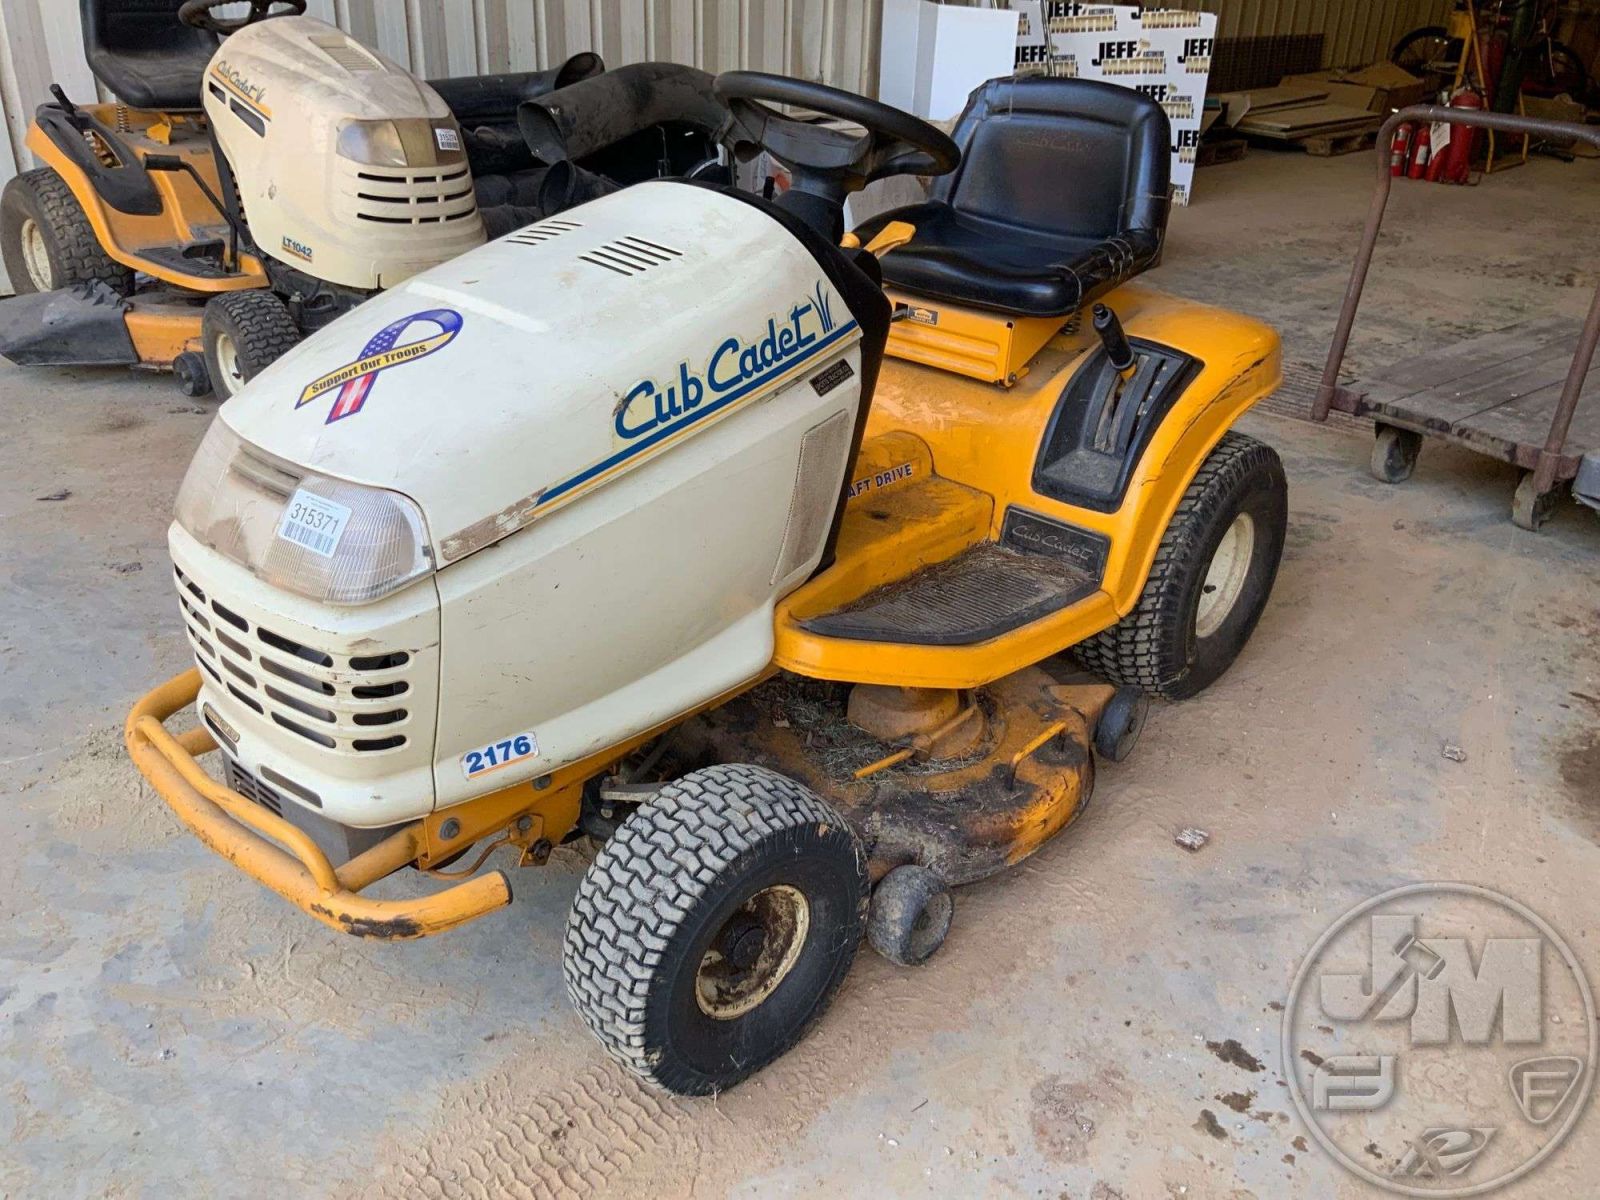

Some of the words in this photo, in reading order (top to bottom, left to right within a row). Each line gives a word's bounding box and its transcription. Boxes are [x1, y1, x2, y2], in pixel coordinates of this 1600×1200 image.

[1092, 41, 1137, 66] JEFF
[282, 235, 313, 258] LT1042
[311, 365, 359, 393] Support
[360, 357, 382, 372] Our
[384, 344, 427, 364] Troops
[615, 362, 704, 439] Cub
[707, 304, 816, 397] Cadet
[875, 463, 913, 488] DRIVE
[291, 502, 340, 535] 315371
[1042, 535, 1094, 561] Cadet
[466, 735, 531, 774] 2176
